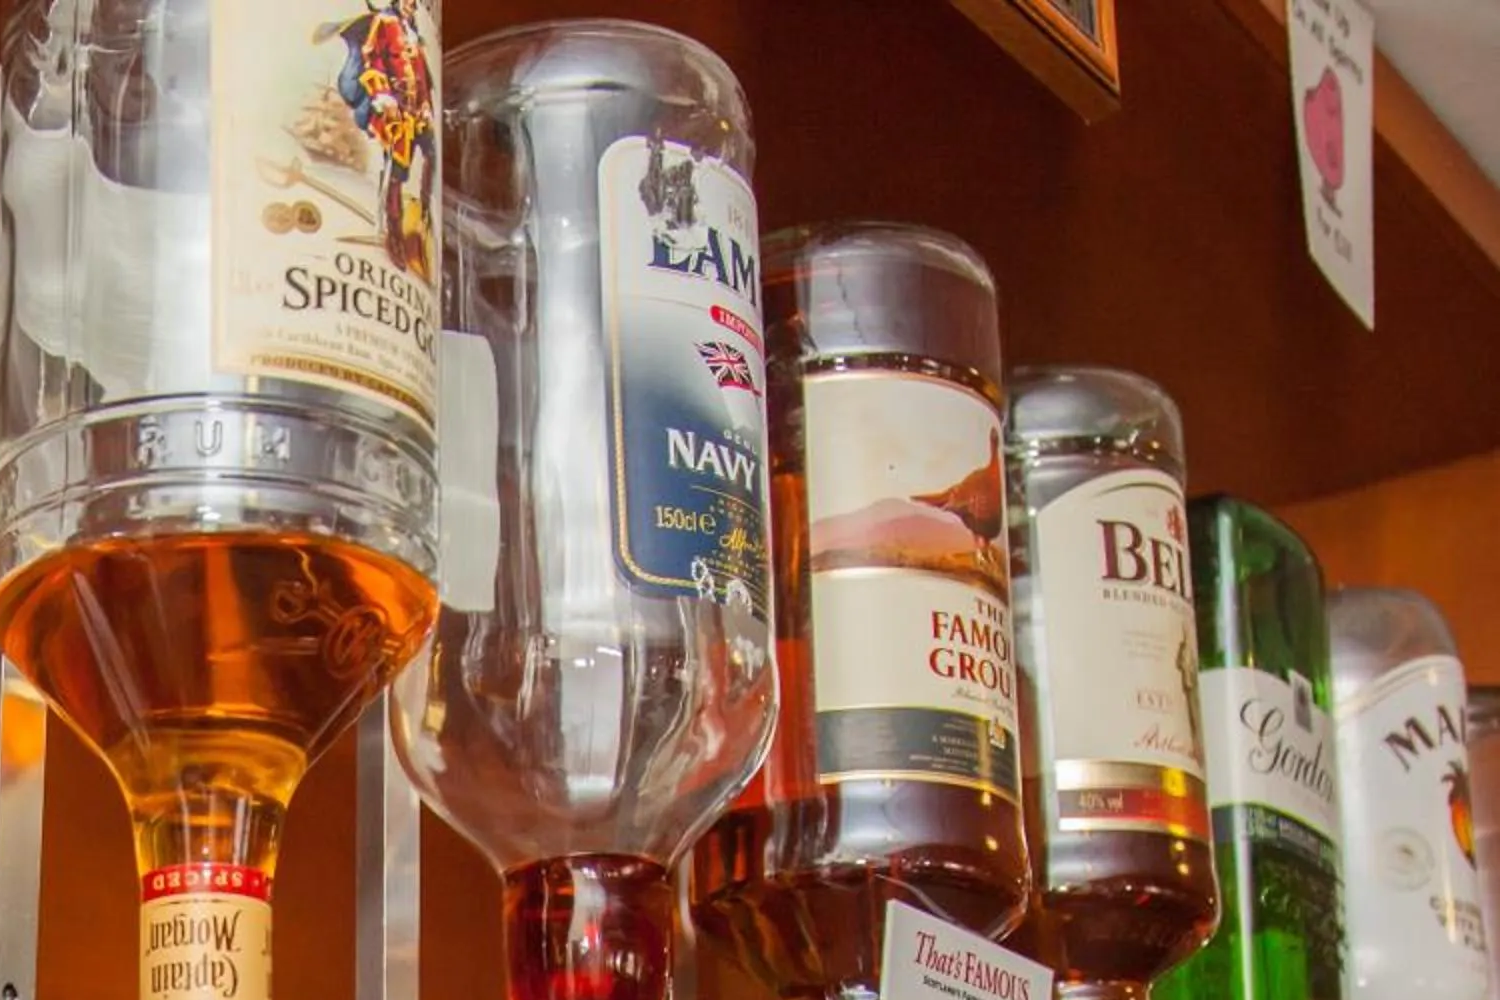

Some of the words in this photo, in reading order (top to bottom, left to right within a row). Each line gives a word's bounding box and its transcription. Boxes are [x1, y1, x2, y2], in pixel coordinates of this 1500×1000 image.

[334, 252, 437, 326] ORIGINA
[647, 224, 758, 308] LAM
[283, 267, 411, 335] SPICED
[665, 427, 757, 493] NAVY
[151, 870, 243, 891] SPICED
[146, 910, 242, 958] Morgan
[915, 930, 963, 980] That's
[151, 953, 238, 998] Captain
